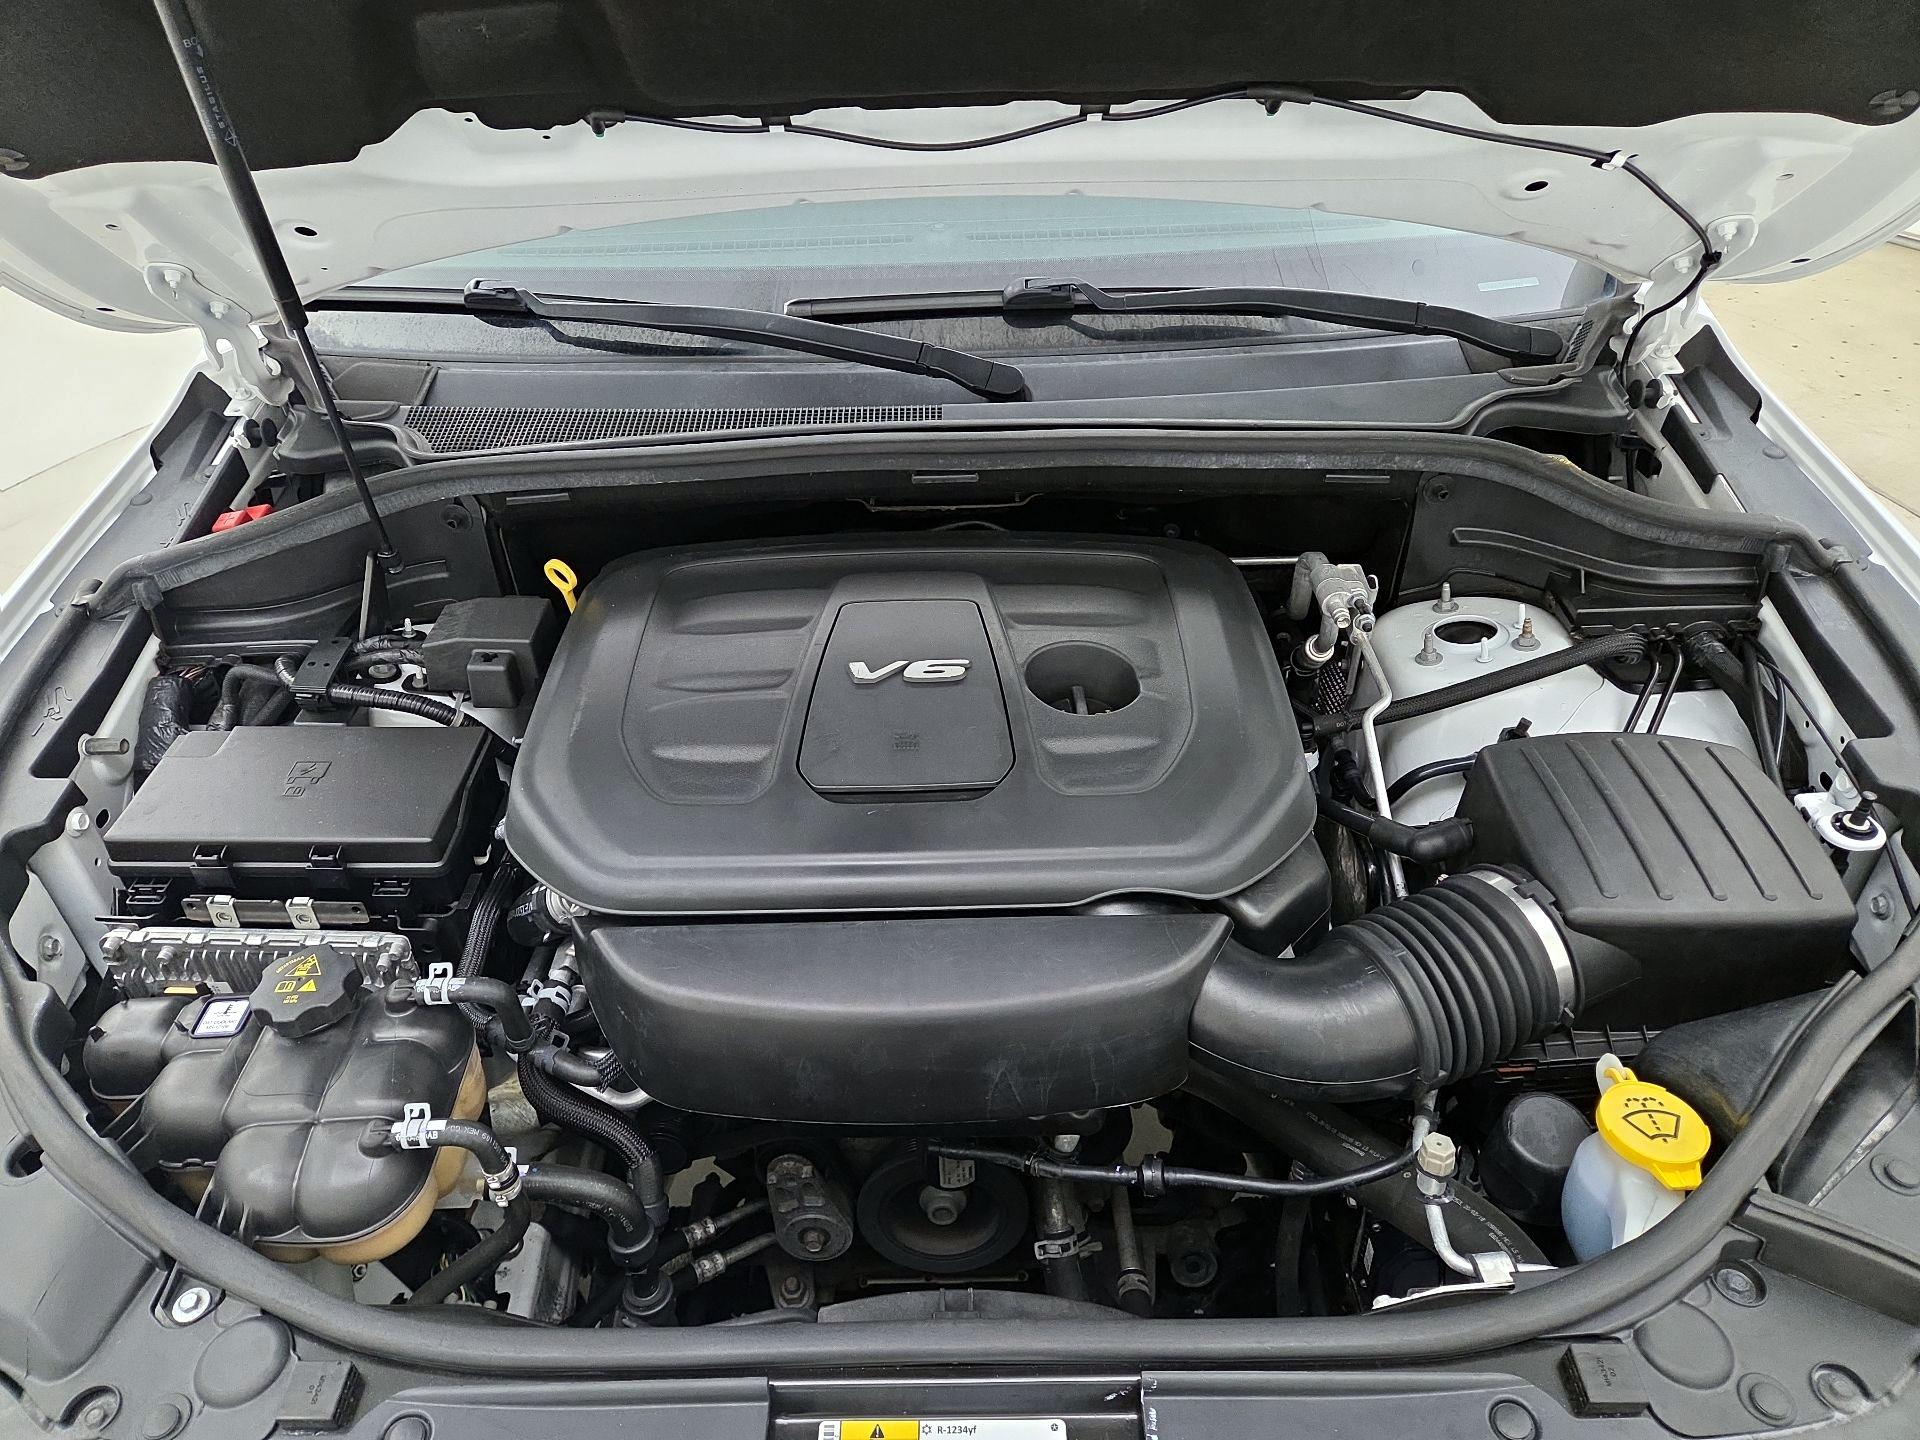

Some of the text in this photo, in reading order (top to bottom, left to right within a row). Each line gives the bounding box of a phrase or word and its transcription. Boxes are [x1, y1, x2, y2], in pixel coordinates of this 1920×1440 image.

[196, 66, 226, 129] STABILUS
[848, 659, 970, 684] V6
[937, 1425, 977, 1436] R-1234yf
